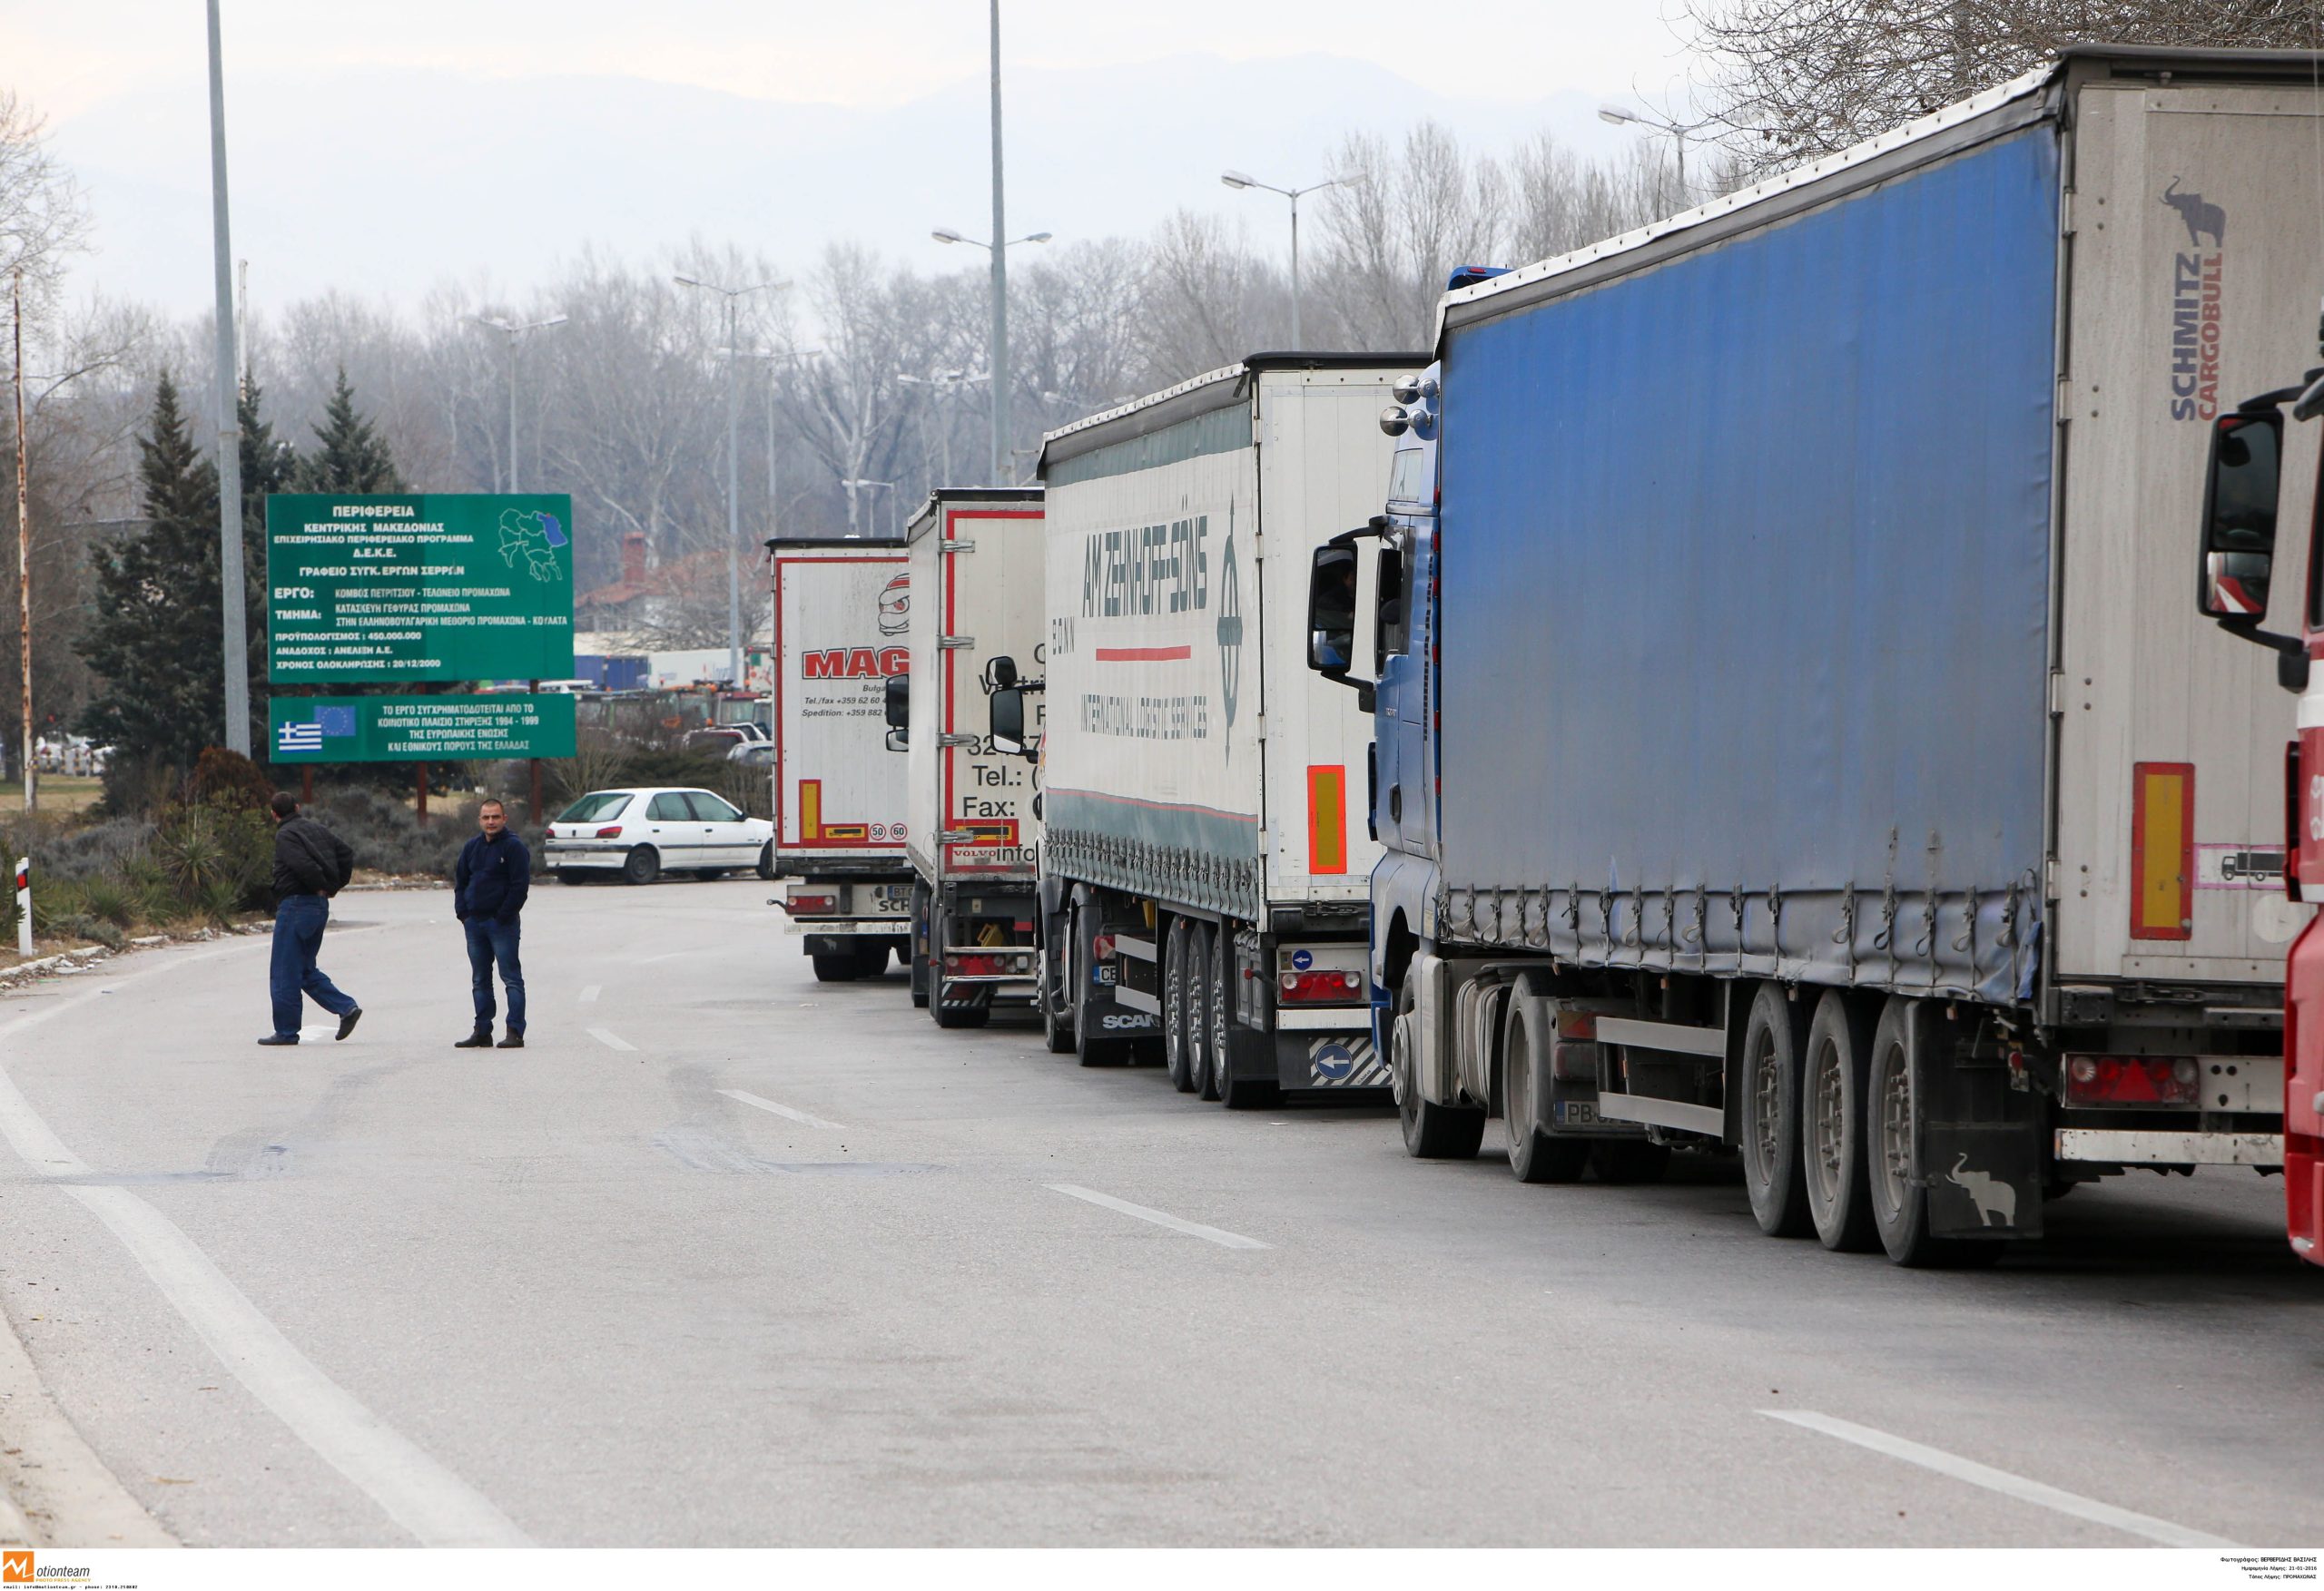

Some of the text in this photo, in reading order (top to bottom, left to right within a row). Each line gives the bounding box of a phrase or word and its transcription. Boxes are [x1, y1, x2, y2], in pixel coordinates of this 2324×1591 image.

[2171, 252, 2201, 421] SCHMITZ
[2199, 252, 2222, 421] CARGOBULL
[332, 506, 414, 517] ΠΕΡΙΦΕΡΕΙΑ
[304, 523, 444, 533] ΚΕΝΤΡΙΚΗΣ ΜΑΚΕΔΟΝΙΑΣ
[274, 535, 345, 544] ΕΠΙΧΕΙΡΗΣΙΑΚΟ
[348, 535, 415, 544] ΠΕΡΙΦΕΡΕΙΑΚΟ
[353, 548, 397, 557] Δ.Ε.Κ.Ε.
[300, 567, 347, 576] ΓΡΑΦΕΙΟ
[1082, 532, 1102, 617] AM
[274, 587, 314, 599] ΕΡΓΟ:
[335, 588, 369, 598] ΚΟΜΒΟΣ
[422, 588, 460, 598] ΤΕΛΩΝΕΙΟ
[462, 588, 510, 596] ΠΡΟΜΑΧΩΝΑ
[383, 604, 419, 613] ΓΕΦΥΡΑΣ
[421, 604, 470, 613] ΠΡΟΜΑΧΩΝΑ
[275, 611, 321, 620] ΤΜΗΜΑ:
[336, 617, 357, 626] ΣΤΗΝ
[1052, 616, 1075, 655] BONN
[276, 646, 326, 655] ΑΝΑΔΟΧΟΣ
[276, 661, 314, 669] ΧΡΟΝΟΣ
[383, 705, 392, 715] ΤΟ
[395, 705, 415, 715] ΕΡΓΟ
[524, 704, 534, 713] ΤΟ
[802, 710, 844, 718] Spedition:
[1081, 693, 1133, 737] INTERNATIONAL
[1137, 697, 1167, 740] LOGISTIC
[1171, 695, 1207, 740] SERVICES
[409, 730, 424, 739] ΤΗΣ
[478, 741, 492, 751] ΤΗΣ
[971, 765, 1021, 786] Tel.:
[963, 797, 1015, 817] Fax:
[872, 828, 883, 836] 50
[893, 828, 904, 836] 60
